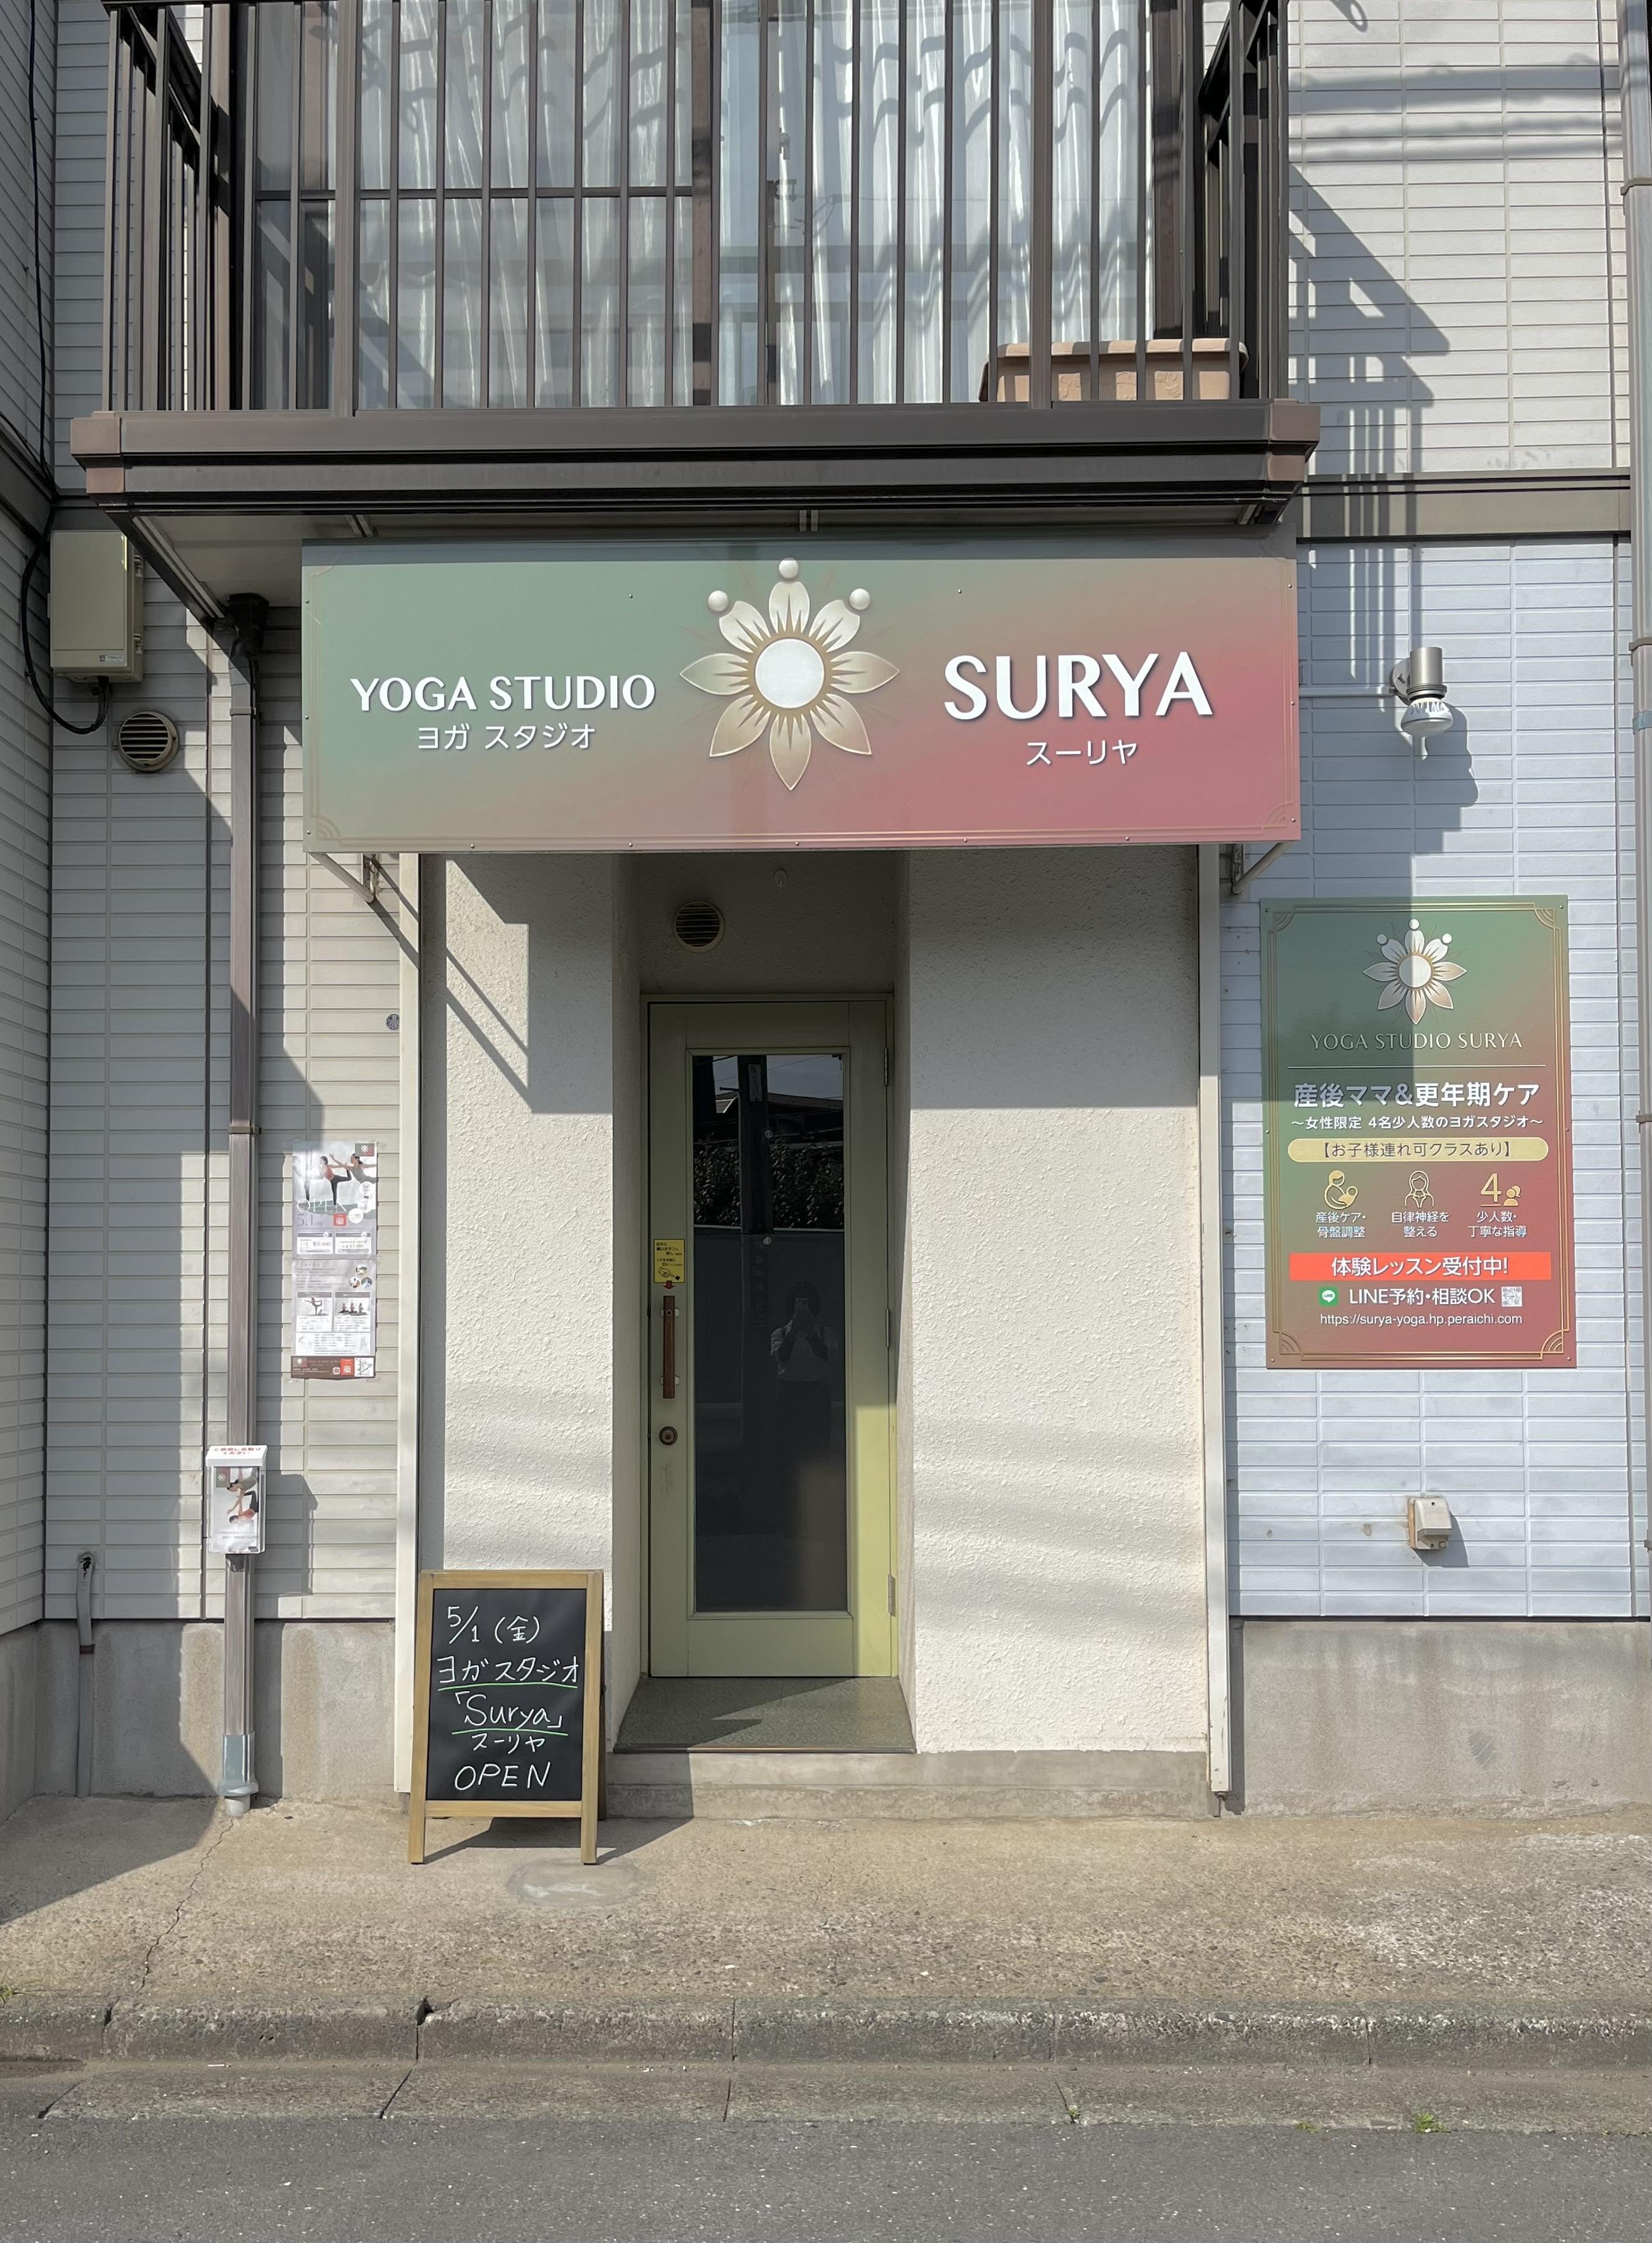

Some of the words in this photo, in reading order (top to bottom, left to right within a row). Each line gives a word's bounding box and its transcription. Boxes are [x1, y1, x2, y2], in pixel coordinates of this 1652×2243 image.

[350, 677, 477, 711] YOGA
[489, 674, 656, 710] STUDIO
[943, 651, 1214, 721] SURYA
[418, 723, 470, 750] ヨガ
[484, 722, 596, 750] スタジオ
[1026, 739, 1138, 765] スーリヤ
[1311, 1032, 1368, 1050] YOGA
[1375, 1032, 1451, 1049] STUDIO
[1458, 1032, 1522, 1048] SURYA
[1293, 1082, 1541, 1108] 産後ママ&更年期ケア
[1322, 1141, 1512, 1158] 【お子様連れ可クラスあり】
[1480, 1173, 1502, 1203] 4
[1392, 1211, 1449, 1223] 自律神経を
[1317, 1226, 1366, 1238] 骨盤調整
[1403, 1226, 1438, 1237] 整える
[1467, 1225, 1527, 1237] 丁寧な指導
[1349, 1288, 1495, 1306] LINE予約・相談OK
[1320, 1314, 1523, 1328] https://surya-yoga.hp.peraichi.com
[471, 1733, 545, 1754] スーリヤ
[454, 1761, 551, 1791] OPEN
